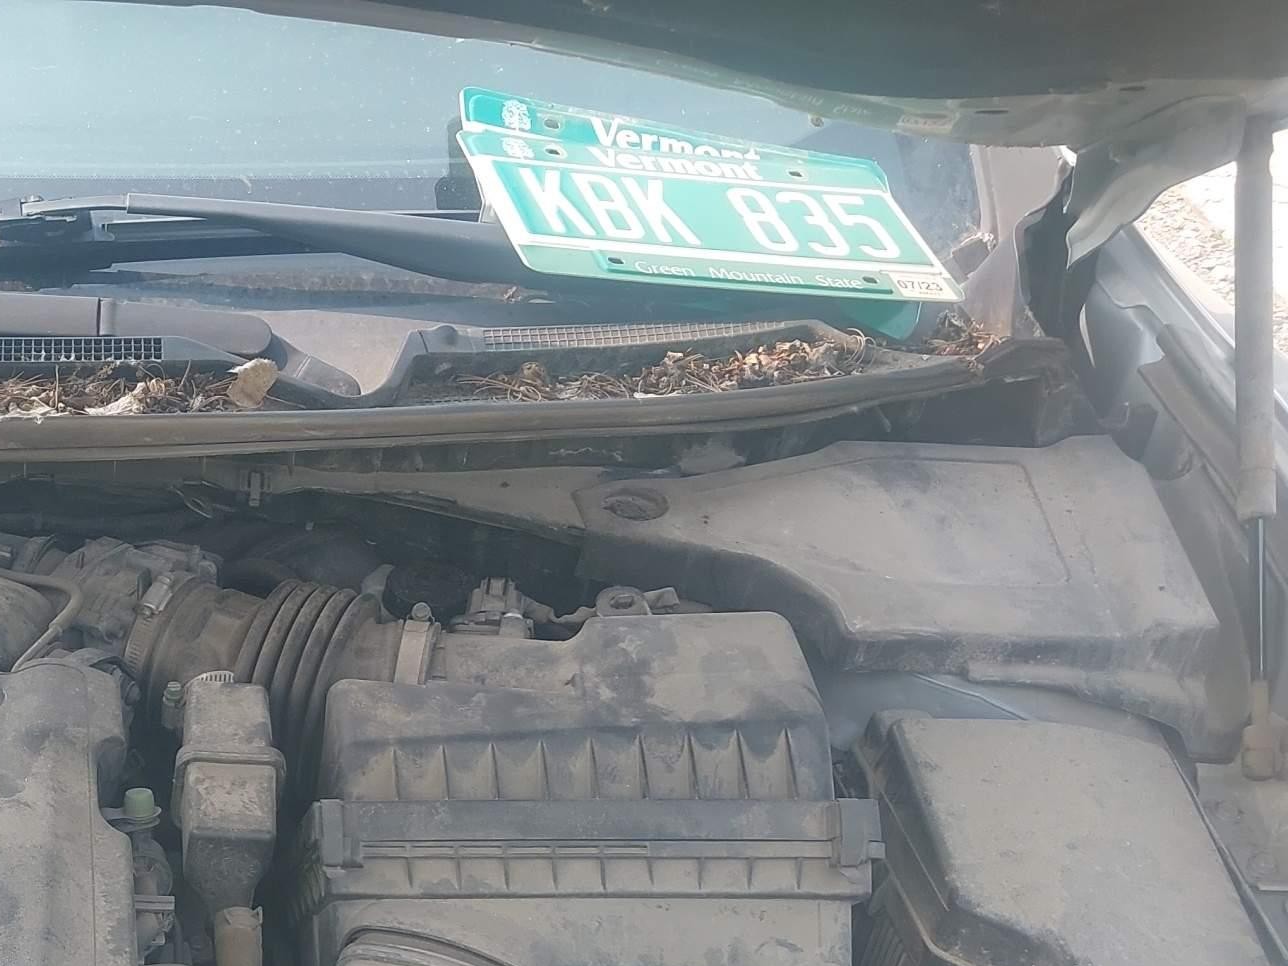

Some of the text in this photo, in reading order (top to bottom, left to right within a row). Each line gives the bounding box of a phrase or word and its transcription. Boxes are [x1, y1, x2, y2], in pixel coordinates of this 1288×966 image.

[586, 146, 764, 181] Vermont
[518, 167, 901, 259] KBK 835
[634, 261, 864, 289] Green Mountain State
